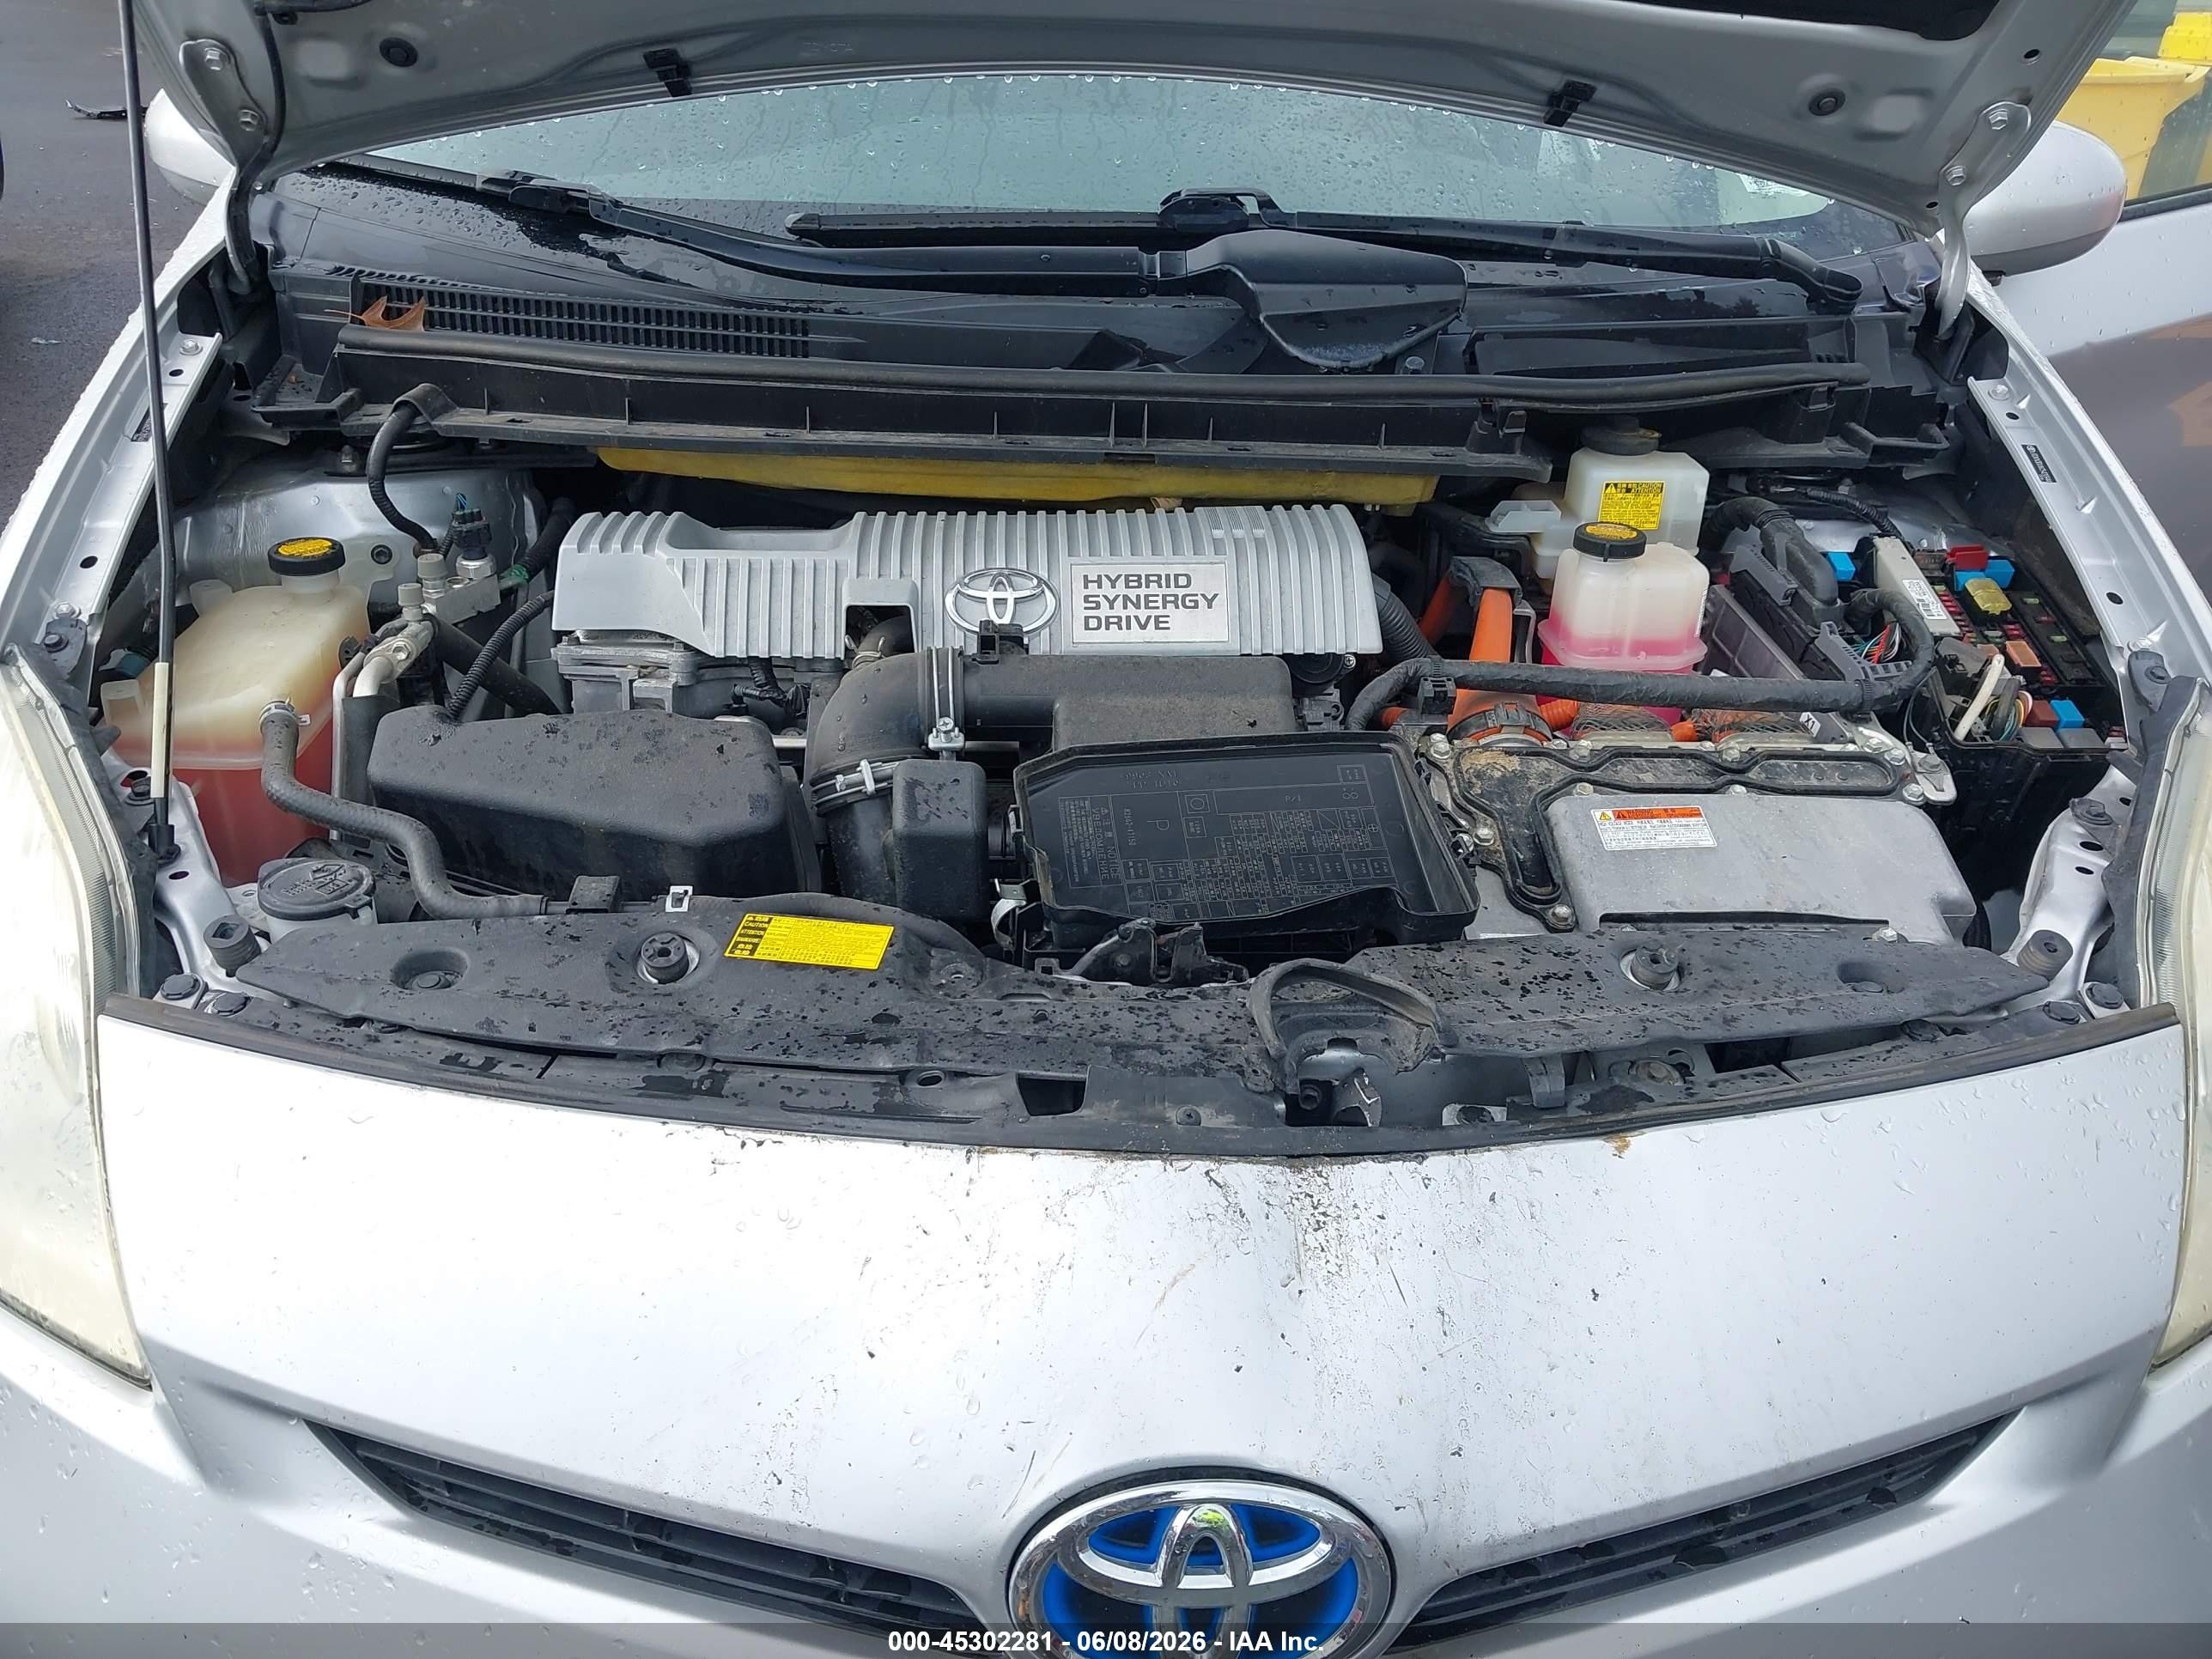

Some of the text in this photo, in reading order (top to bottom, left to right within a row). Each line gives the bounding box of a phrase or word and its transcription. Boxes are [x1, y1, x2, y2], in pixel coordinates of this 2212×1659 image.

[1083, 574, 1192, 589] HYBRID
[1083, 593, 1219, 610] SYNERGY
[1084, 615, 1170, 631] DRIVE
[1804, 714, 1815, 730] X1
[1091, 807, 1109, 880] УВЕДОМЛЕНИЕ
[1107, 845, 1121, 879] NOTICE
